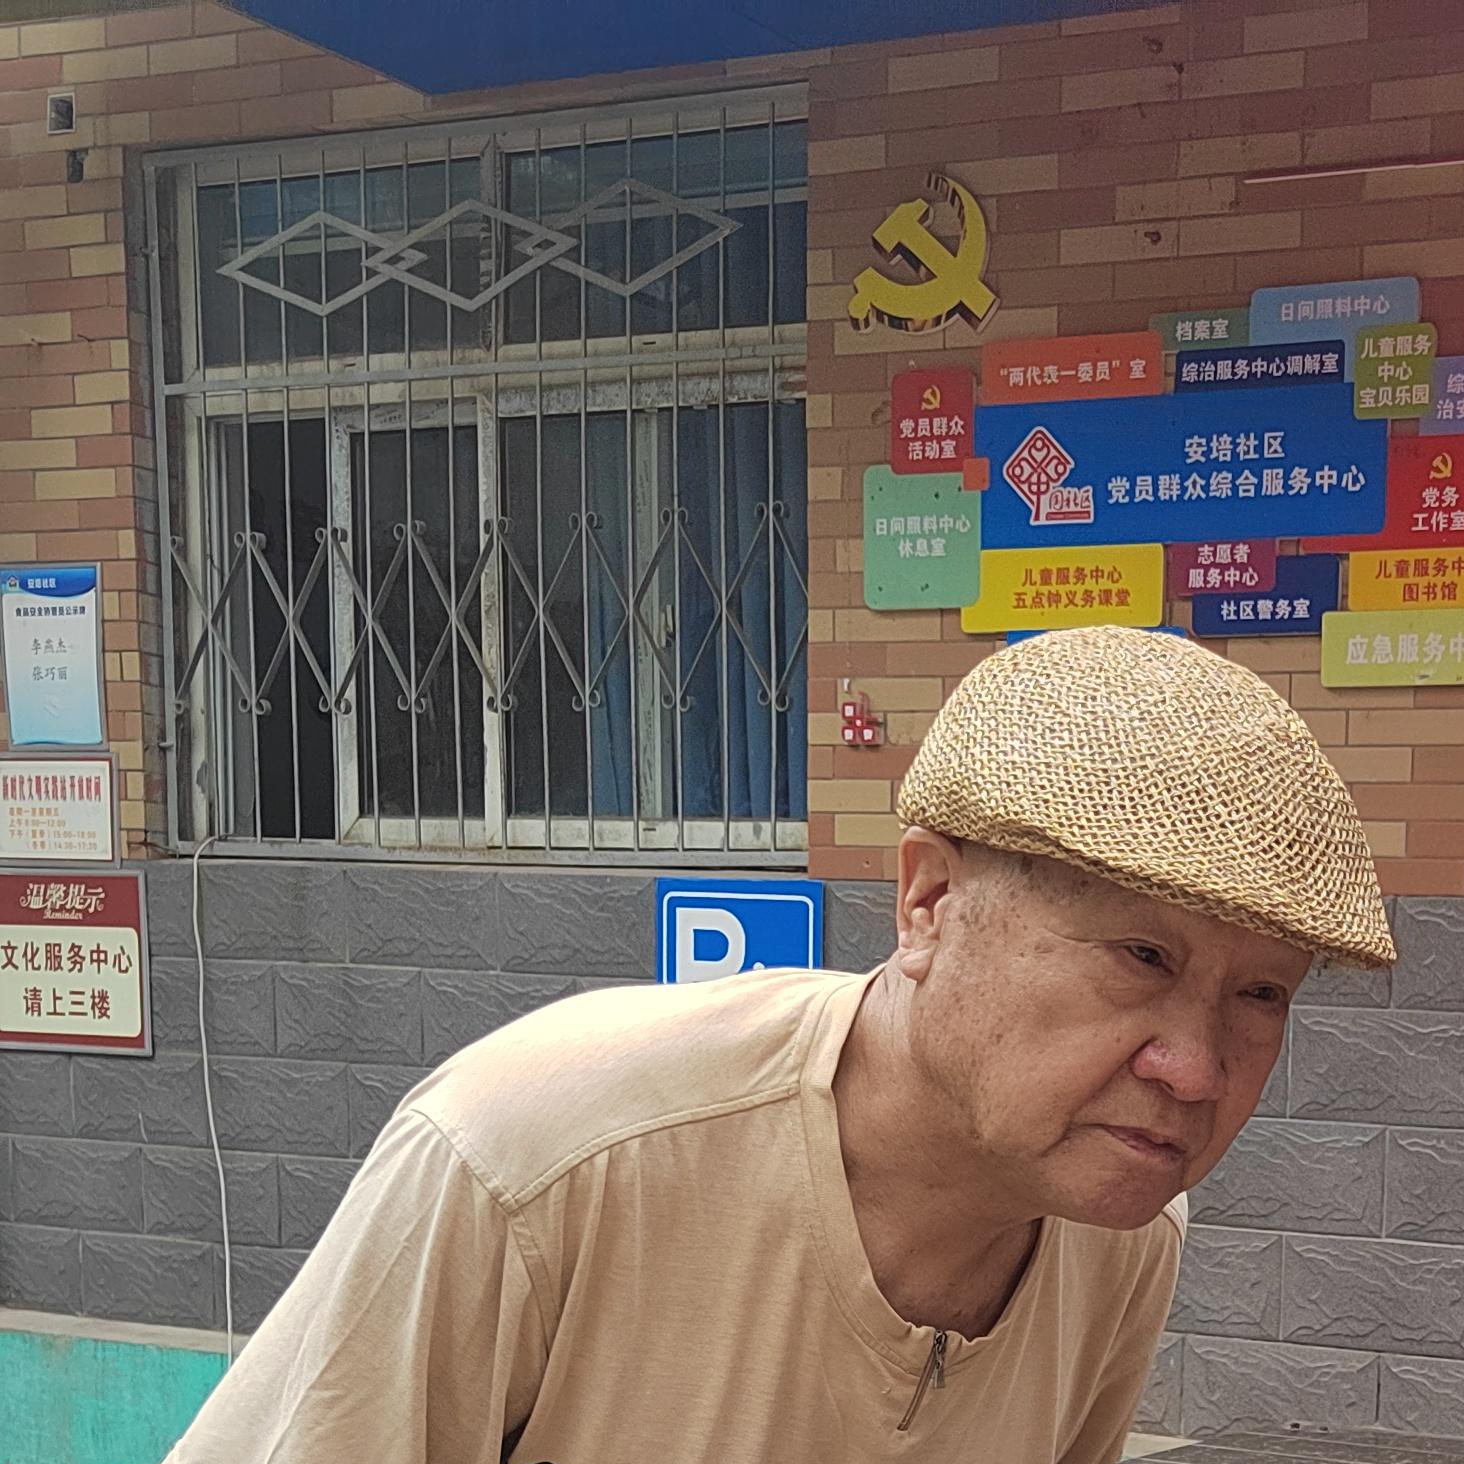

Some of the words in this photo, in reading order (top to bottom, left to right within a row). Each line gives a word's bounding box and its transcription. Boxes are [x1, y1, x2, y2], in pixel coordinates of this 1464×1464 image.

[1280, 295, 1391, 322] 日间照料中心
[1175, 319, 1229, 342] 档案室
[1361, 334, 1432, 358] 儿童服务
[1181, 353, 1339, 383] 综治服务中心调解室
[1377, 362, 1413, 381] 中心
[1359, 384, 1430, 409] 宝贝乐园
[900, 416, 965, 437] 党员群众
[908, 439, 957, 460] 活动室
[1184, 432, 1285, 462] 安培社区
[1107, 465, 1366, 505] 党员群众综合服务中心
[1422, 486, 1460, 508] 党务
[875, 515, 971, 535] 日间照料中心
[898, 537, 946, 558] 休息室
[1197, 543, 1251, 565] 志愿者
[1022, 565, 1122, 587] 儿童服务中心
[1188, 566, 1260, 589] 服务中心
[1012, 587, 1131, 610] 五点钟义务课堂
[1402, 581, 1458, 603] 图书馆
[1220, 599, 1310, 621] 社区警务室
[20, 883, 105, 913] 温馨提示
[43, 909, 83, 920] Reminder
[676, 906, 746, 984] P
[0, 940, 133, 975] 文化服务中心
[23, 986, 111, 1020] 请上三楼
